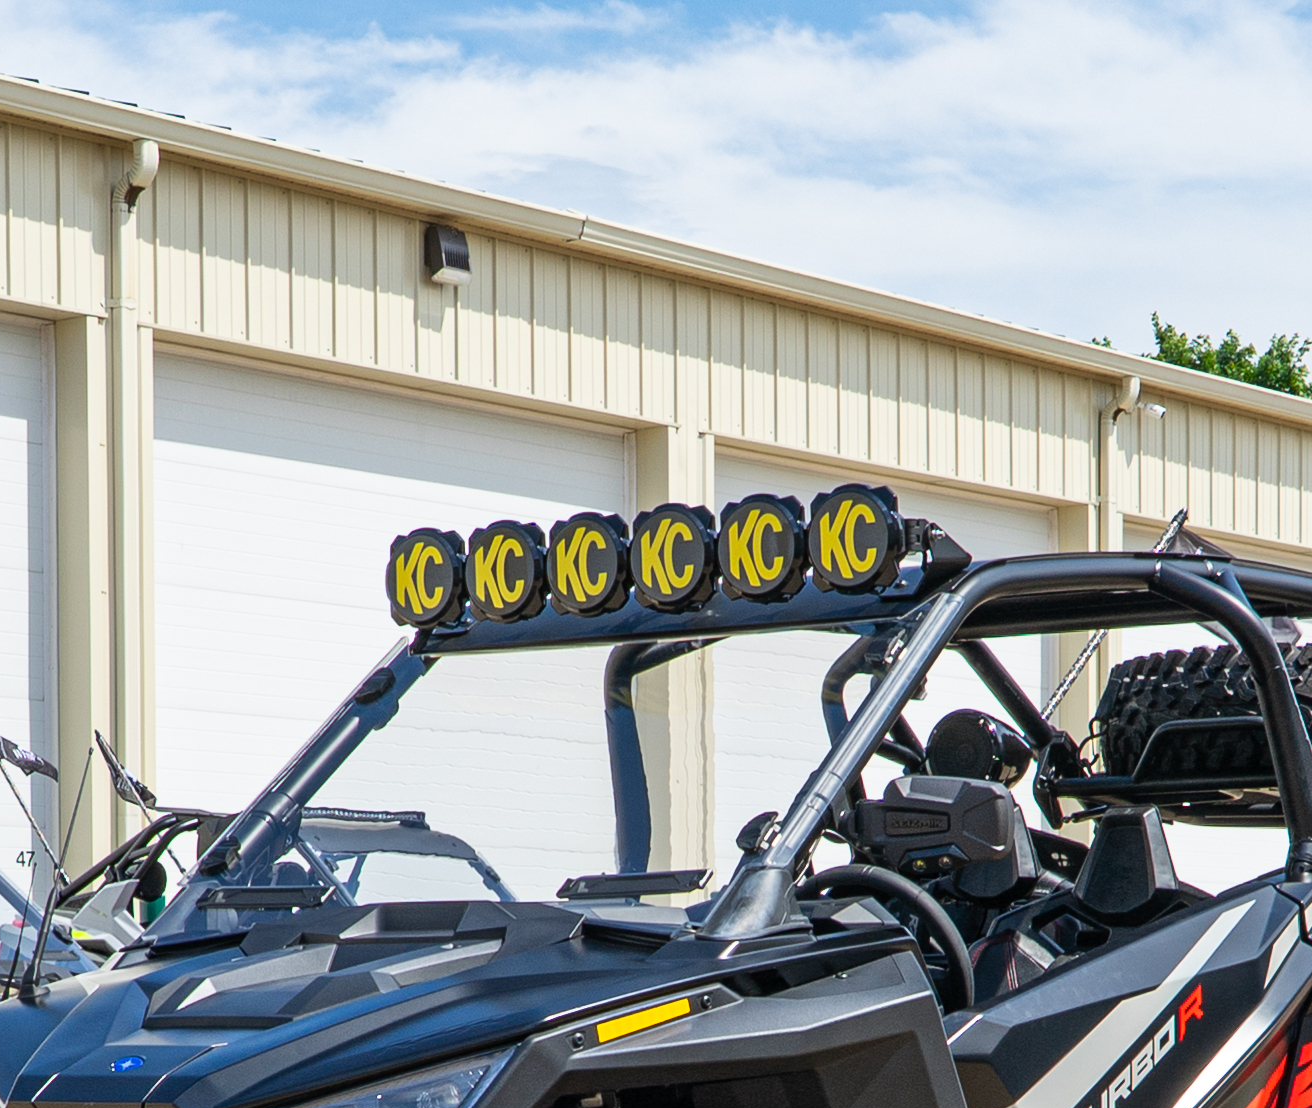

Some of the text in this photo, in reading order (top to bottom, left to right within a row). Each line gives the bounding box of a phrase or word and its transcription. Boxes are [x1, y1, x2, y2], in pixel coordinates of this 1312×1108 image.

[395, 542, 444, 615] KC
[474, 534, 525, 609] KC
[556, 526, 608, 603] KC
[640, 519, 694, 596] KC
[728, 509, 784, 588] KC
[819, 500, 877, 580] KC
[15, 850, 35, 867] 47
